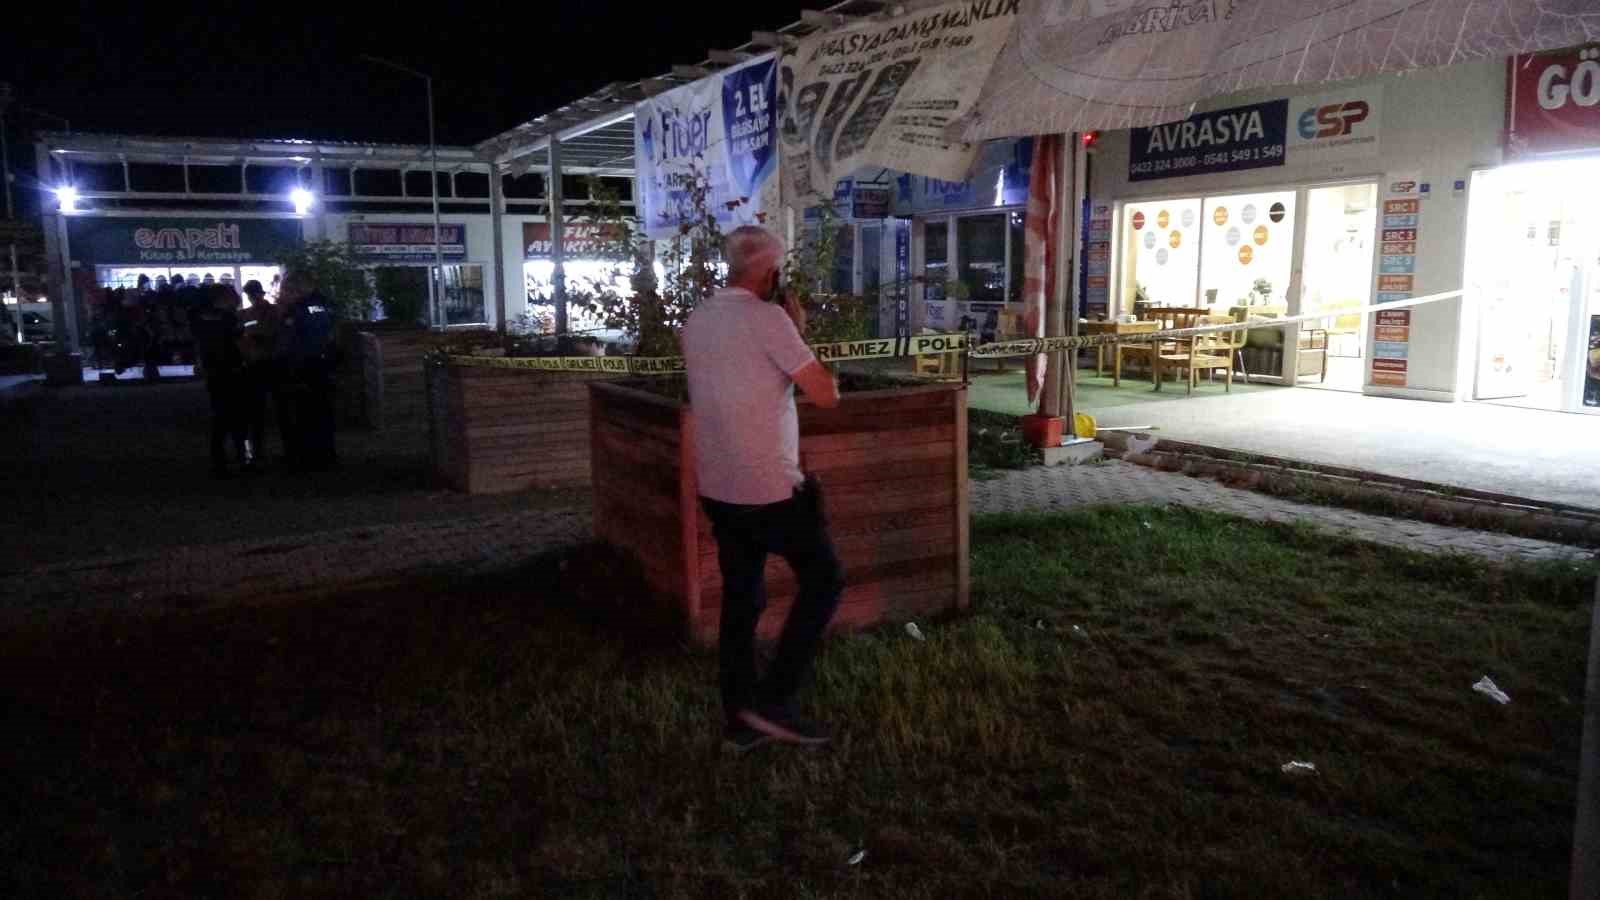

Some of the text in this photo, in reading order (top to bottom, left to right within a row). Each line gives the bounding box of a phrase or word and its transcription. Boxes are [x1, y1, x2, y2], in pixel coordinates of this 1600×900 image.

[1146, 110, 1265, 153] AVRASYA
[1263, 144, 1283, 160] 549
[1385, 231, 1407, 241] SRC
